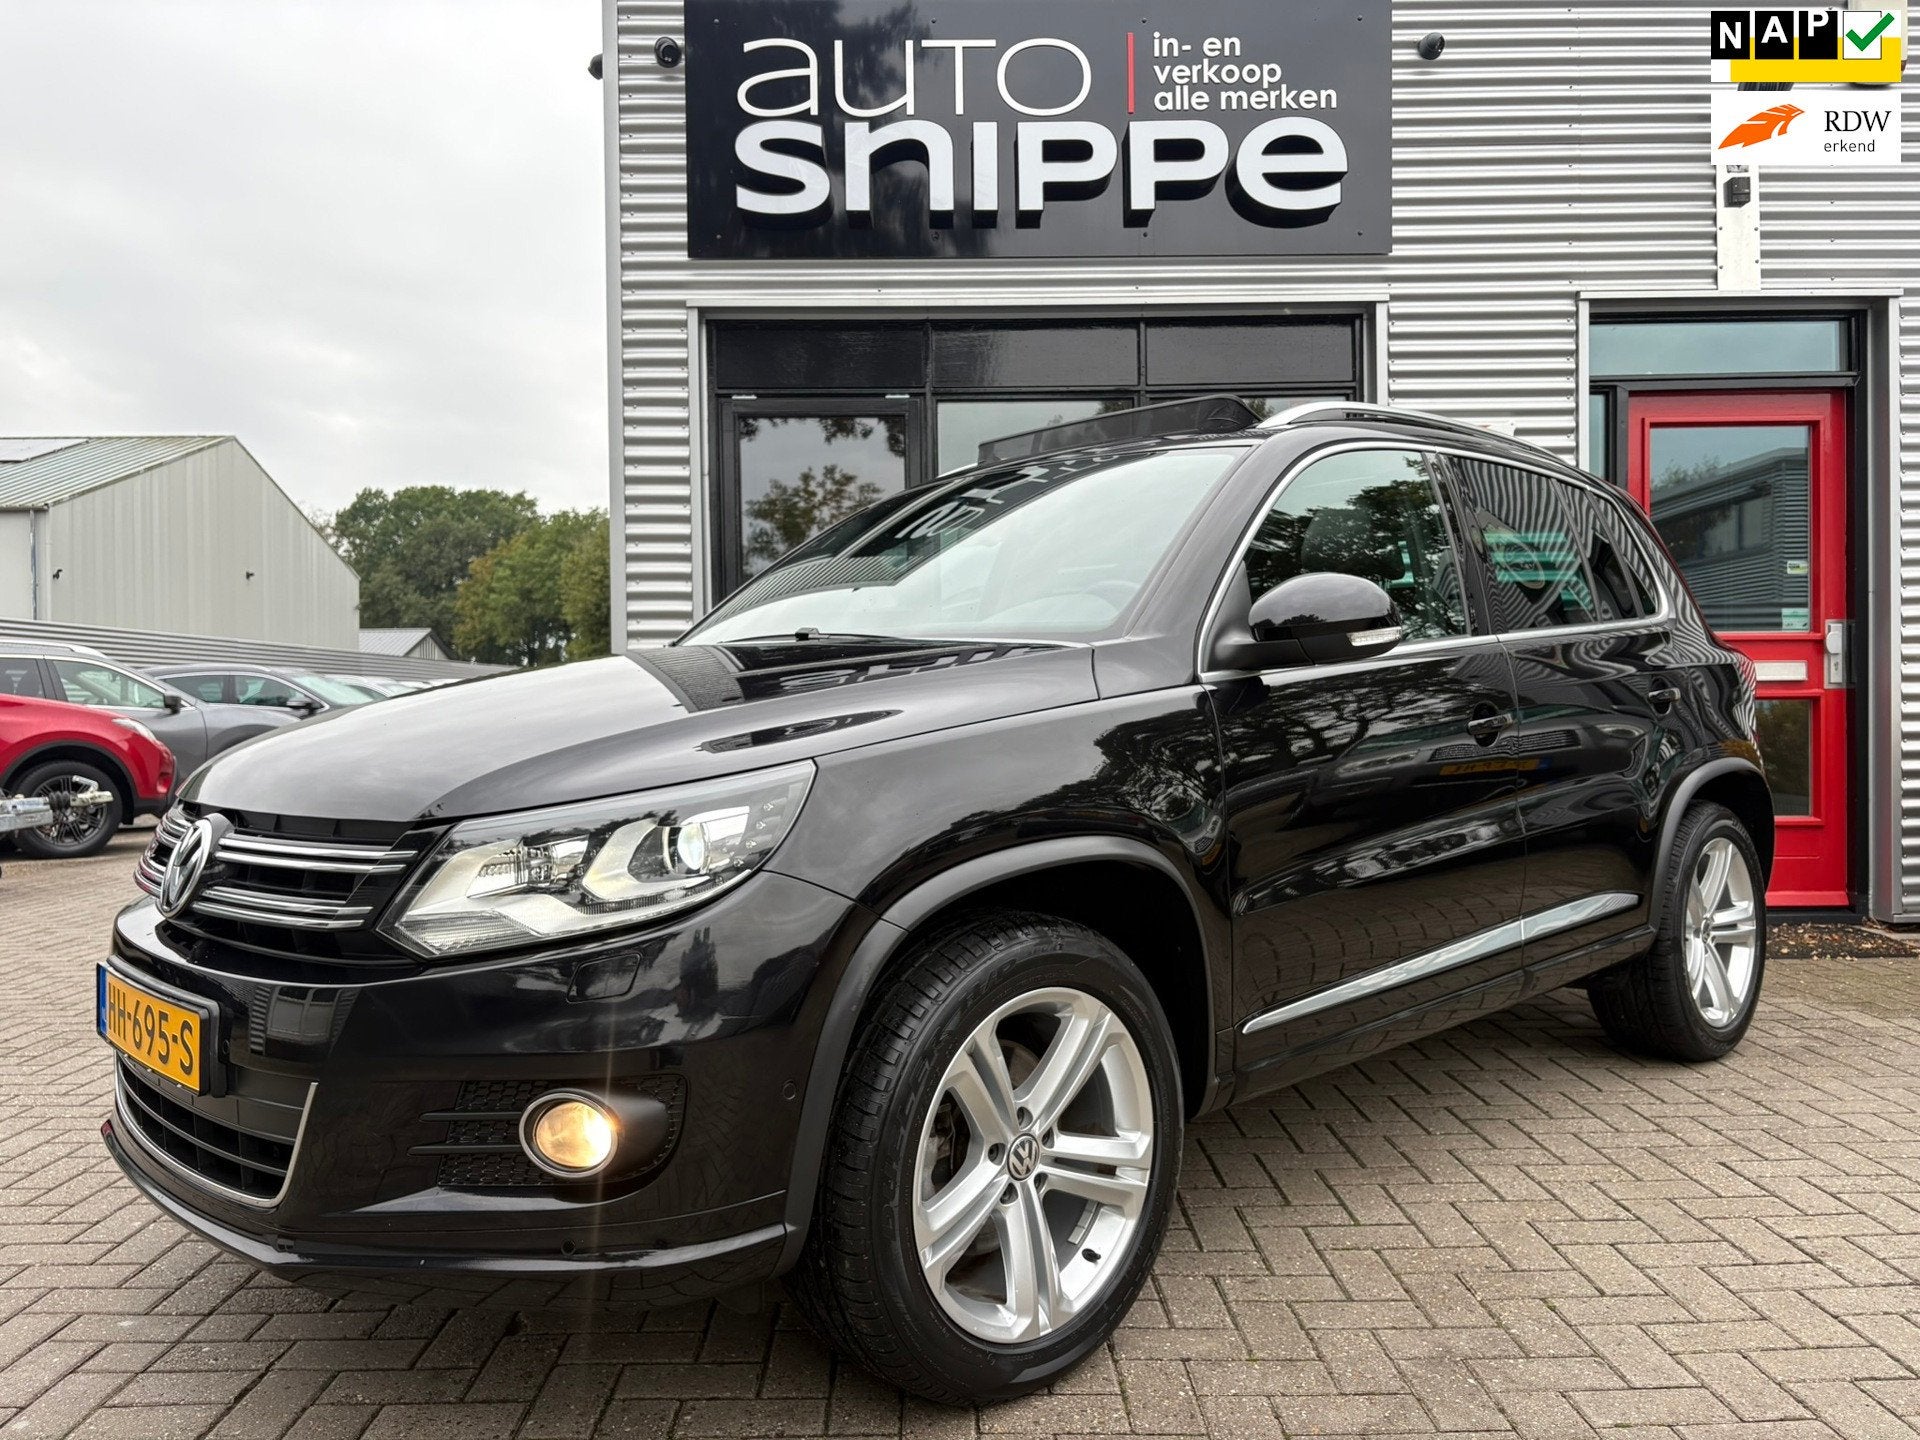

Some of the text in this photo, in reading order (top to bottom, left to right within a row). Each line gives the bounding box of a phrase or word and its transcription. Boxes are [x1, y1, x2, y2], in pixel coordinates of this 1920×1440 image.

[1153, 32, 1241, 58] in- en
[1153, 58, 1282, 89] verkoop
[1153, 84, 1337, 111] alle merken
[108, 981, 194, 1076] HH-695-S
